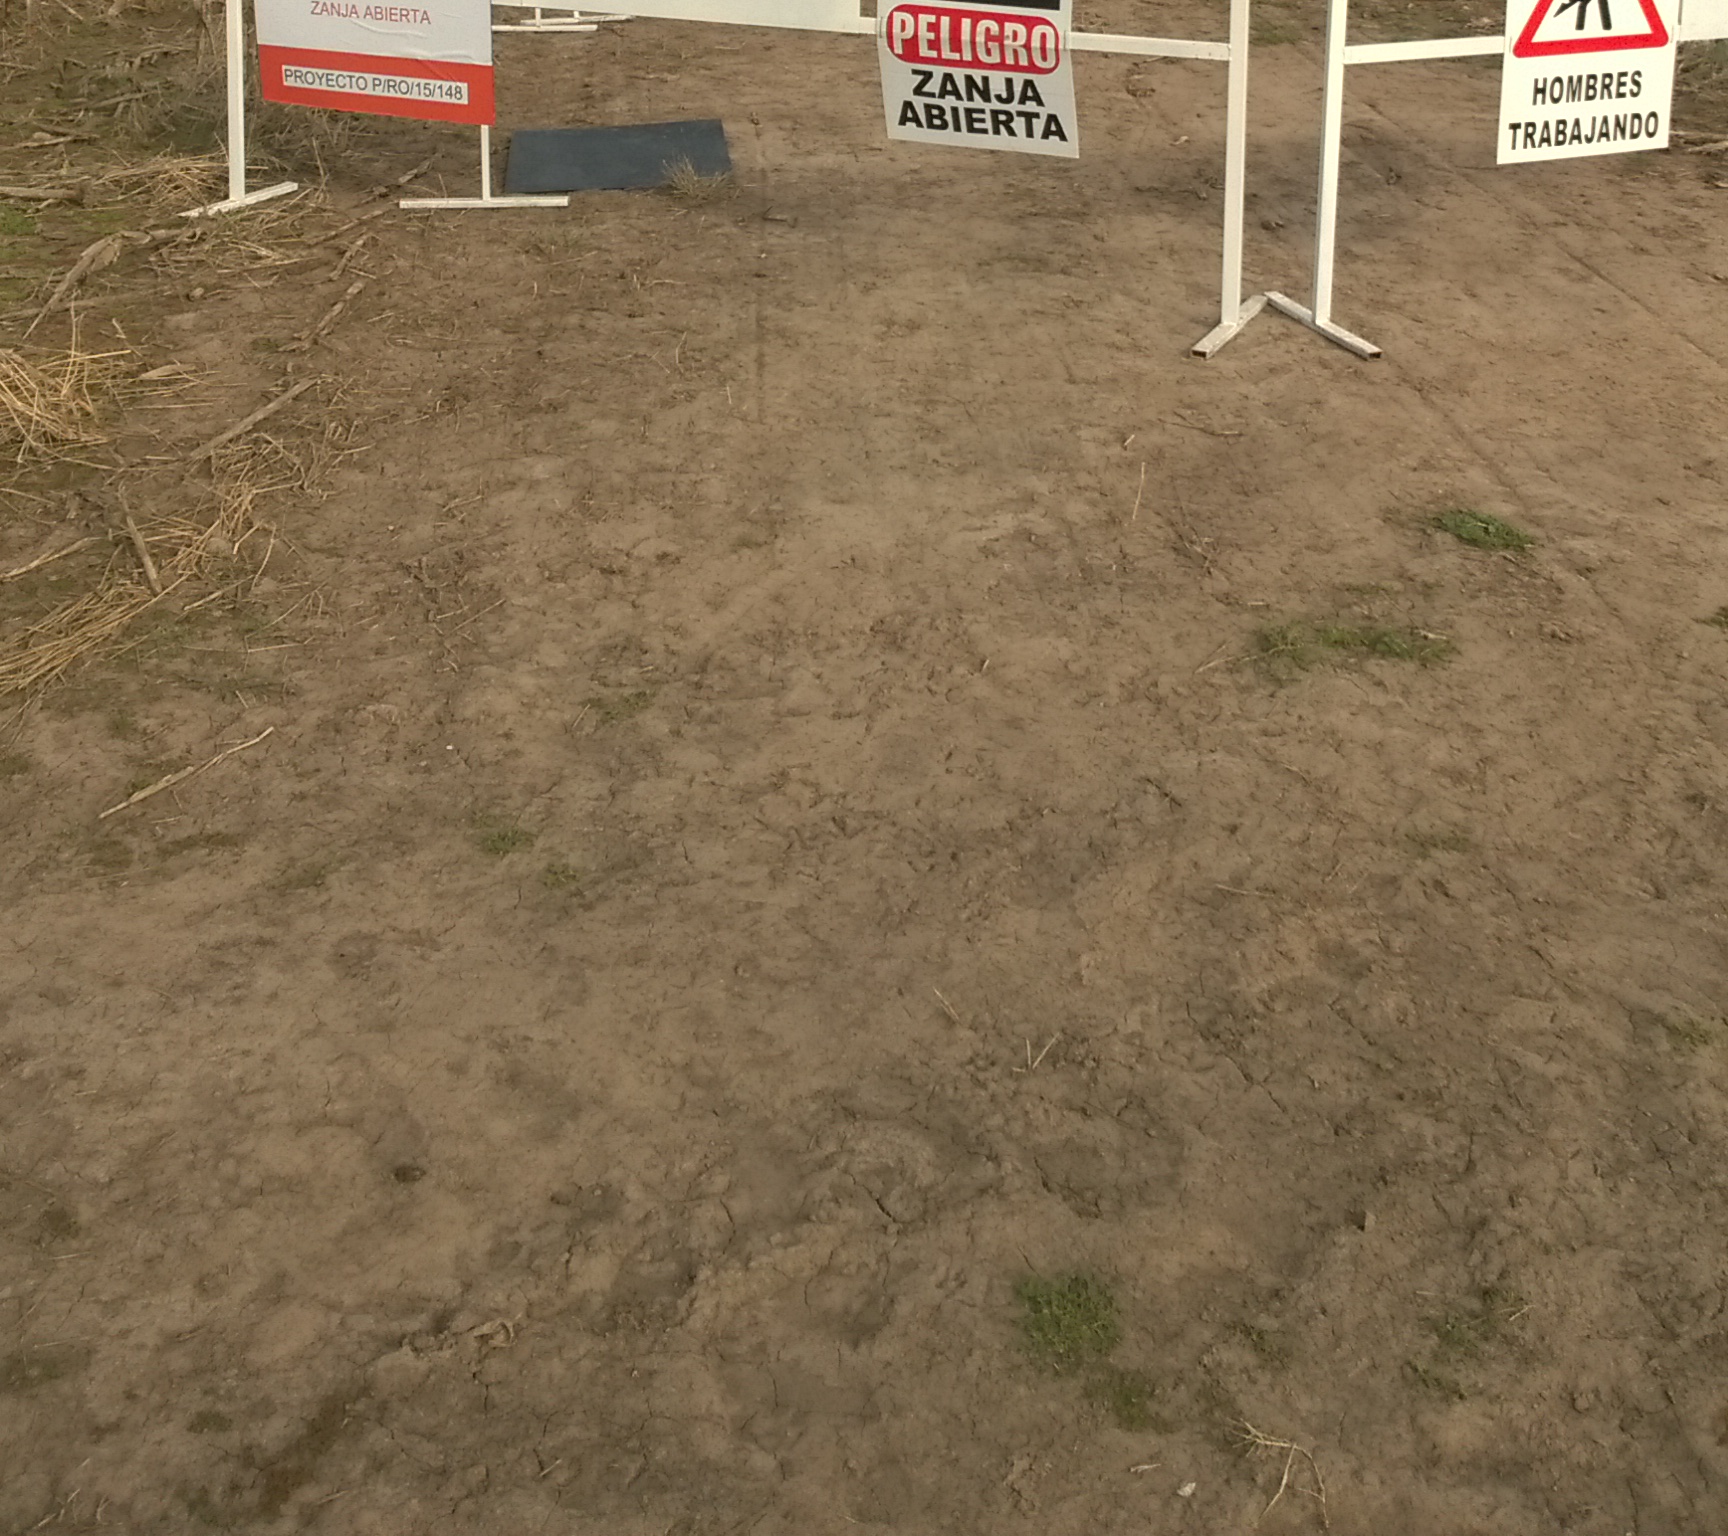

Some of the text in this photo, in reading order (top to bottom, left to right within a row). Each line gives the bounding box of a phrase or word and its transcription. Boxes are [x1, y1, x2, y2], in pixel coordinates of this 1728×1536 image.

[310, 1, 431, 24] ZANJA ABIERTA
[892, 11, 1056, 69] PELIGRO
[284, 68, 463, 101] PROYECTO P/RO/15/148
[911, 68, 1045, 107] ZANJA
[1532, 70, 1642, 106] HOMBRES
[898, 100, 1068, 142] ABIERTA
[1508, 111, 1659, 150] TRABAJANDO
